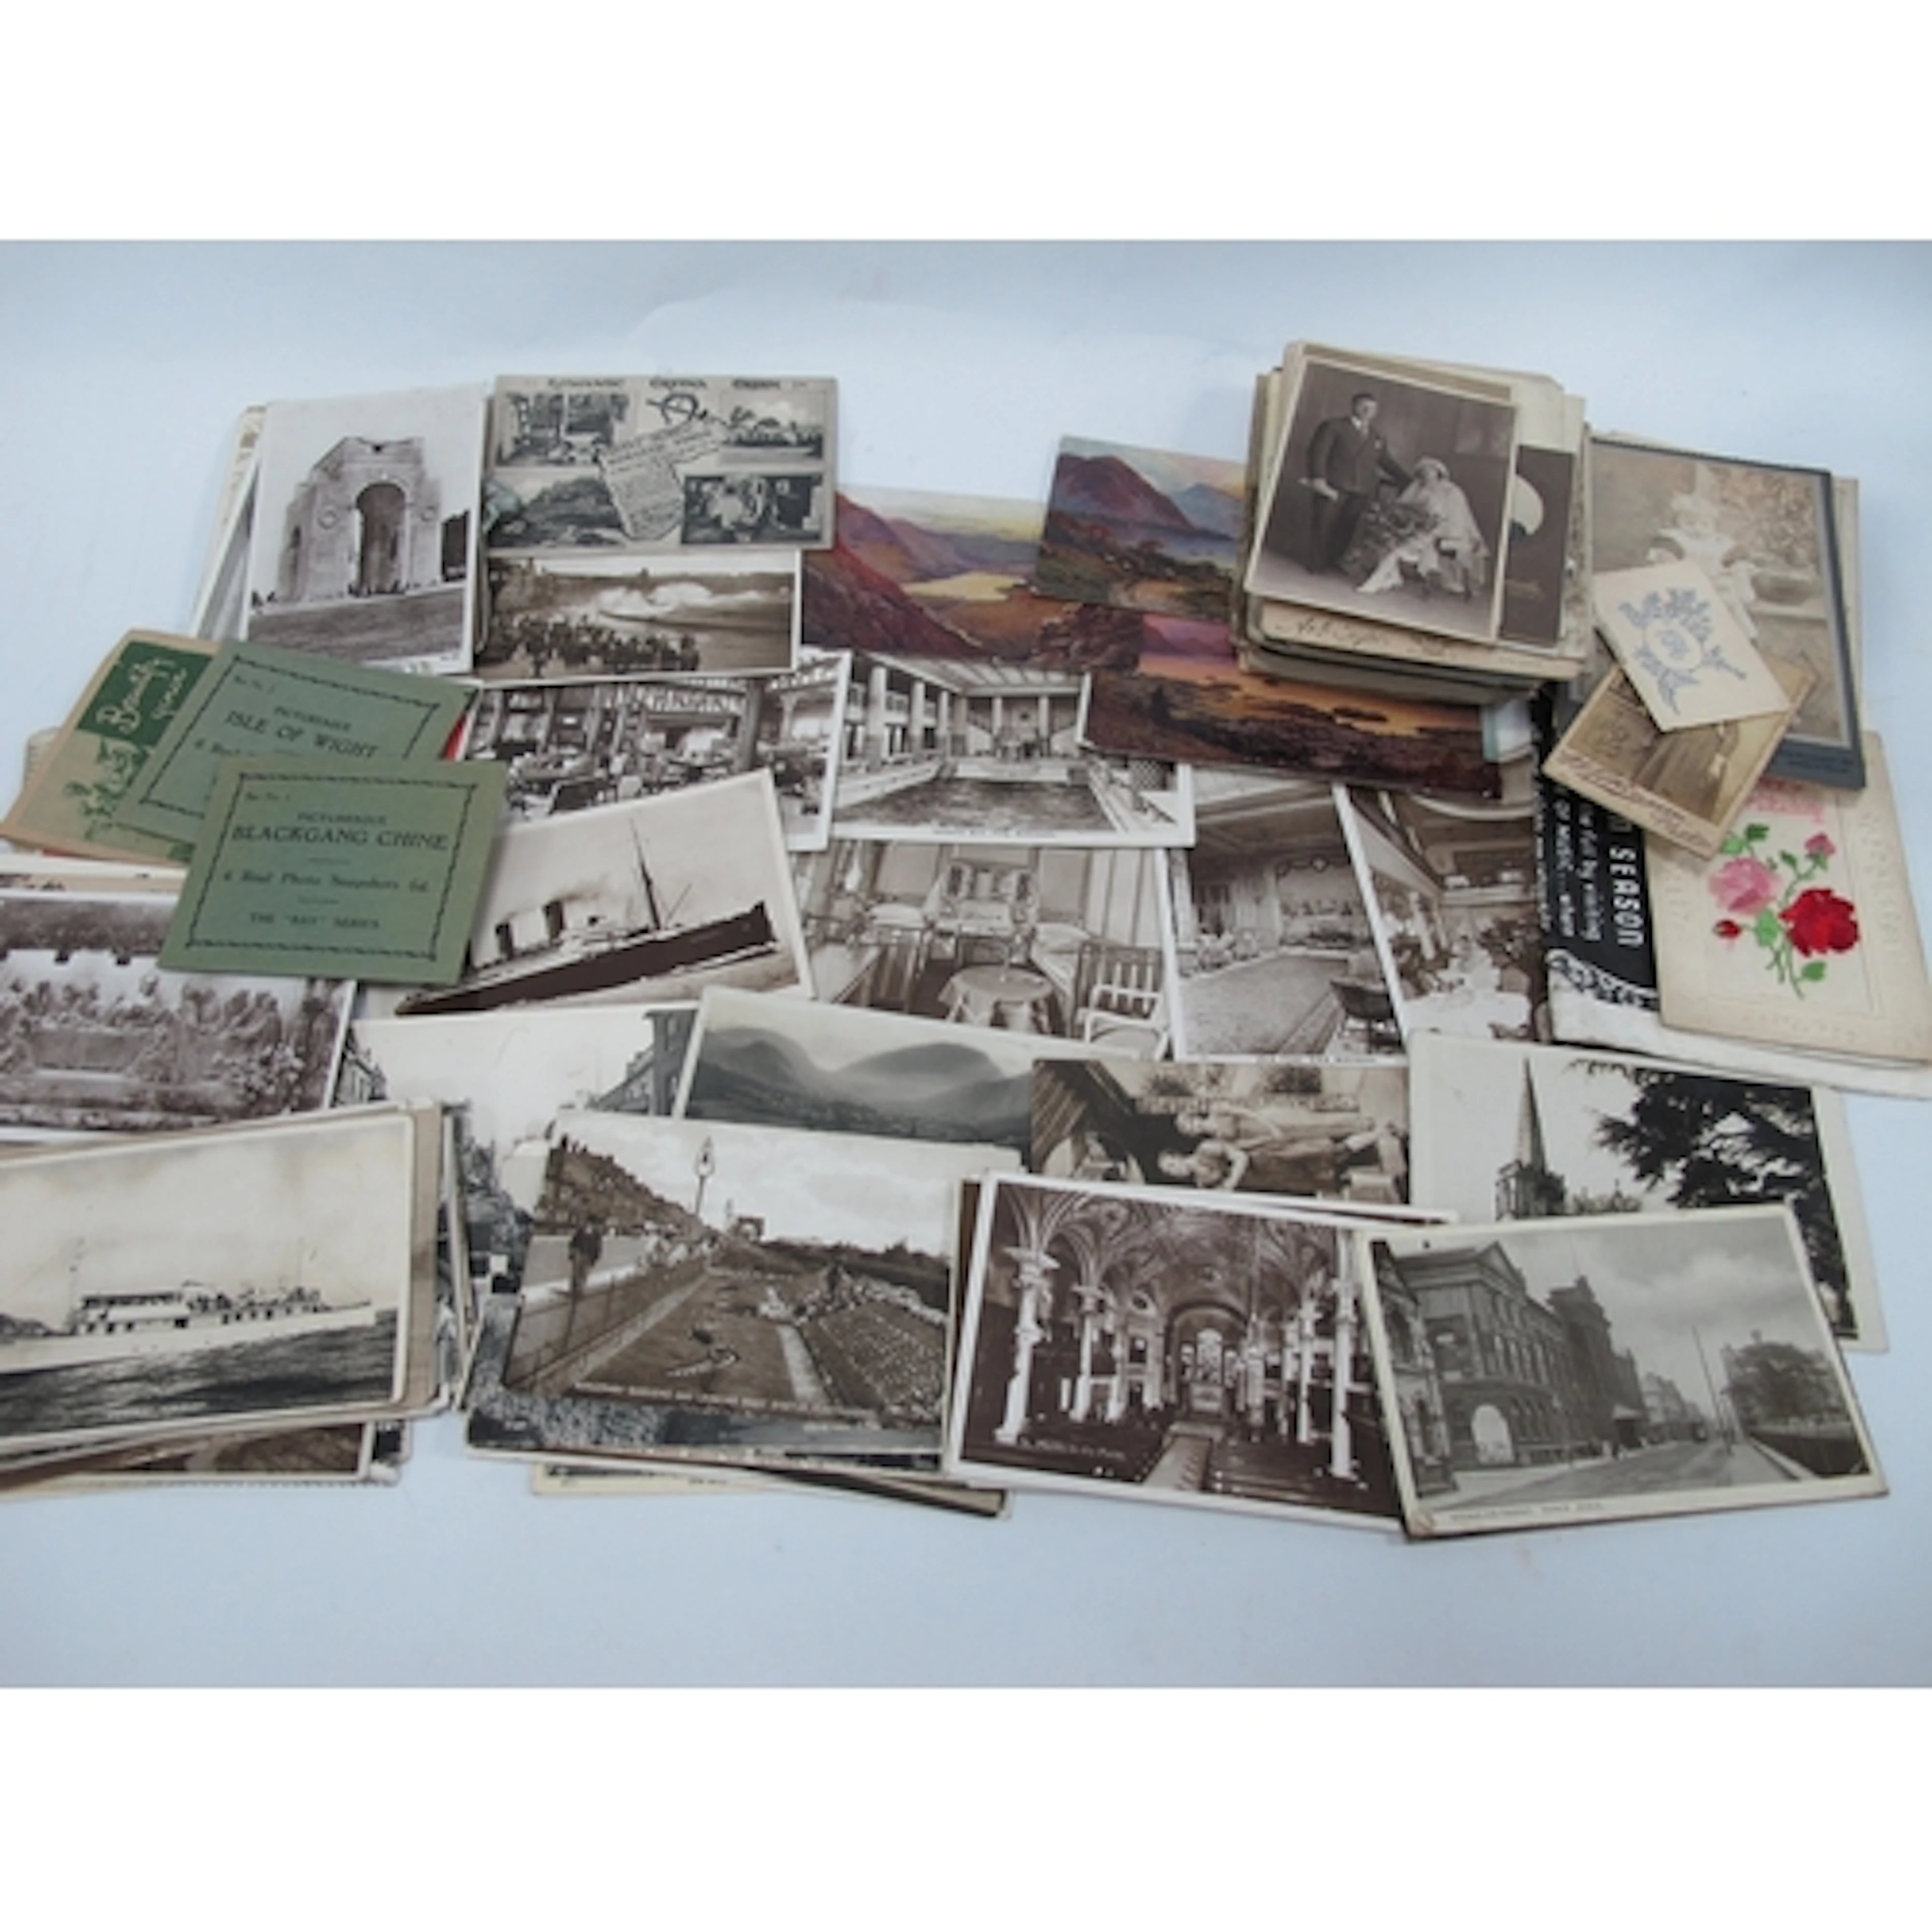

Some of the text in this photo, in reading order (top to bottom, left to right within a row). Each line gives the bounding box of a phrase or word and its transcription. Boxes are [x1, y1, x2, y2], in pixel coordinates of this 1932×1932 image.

[224, 709, 379, 758] ISLE OF WIGHT
[231, 824, 449, 851] BLACKGANG CHINE
[281, 872, 321, 886] Photo
[1609, 847, 1645, 946] SEASON
[250, 912, 275, 925] THE
